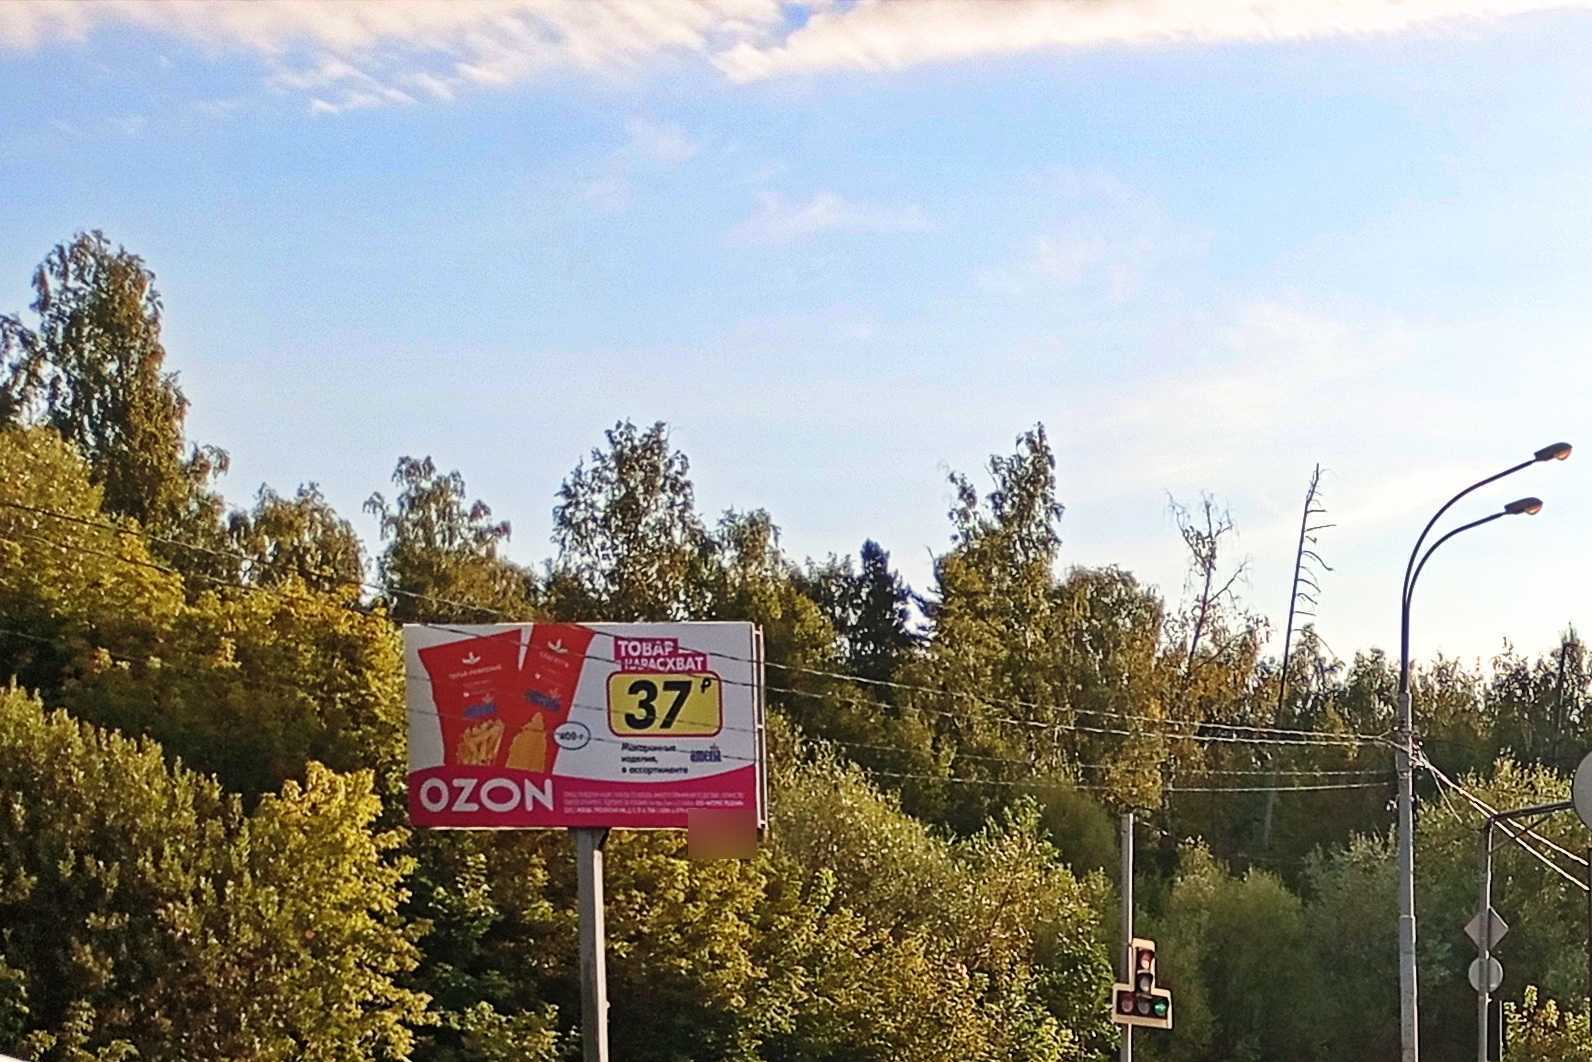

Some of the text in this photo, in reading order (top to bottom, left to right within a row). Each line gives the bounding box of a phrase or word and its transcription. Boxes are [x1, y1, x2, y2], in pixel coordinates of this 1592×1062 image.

[618, 640, 674, 657] ТОВАР
[624, 679, 693, 730] 37
[419, 776, 554, 813] OZON
